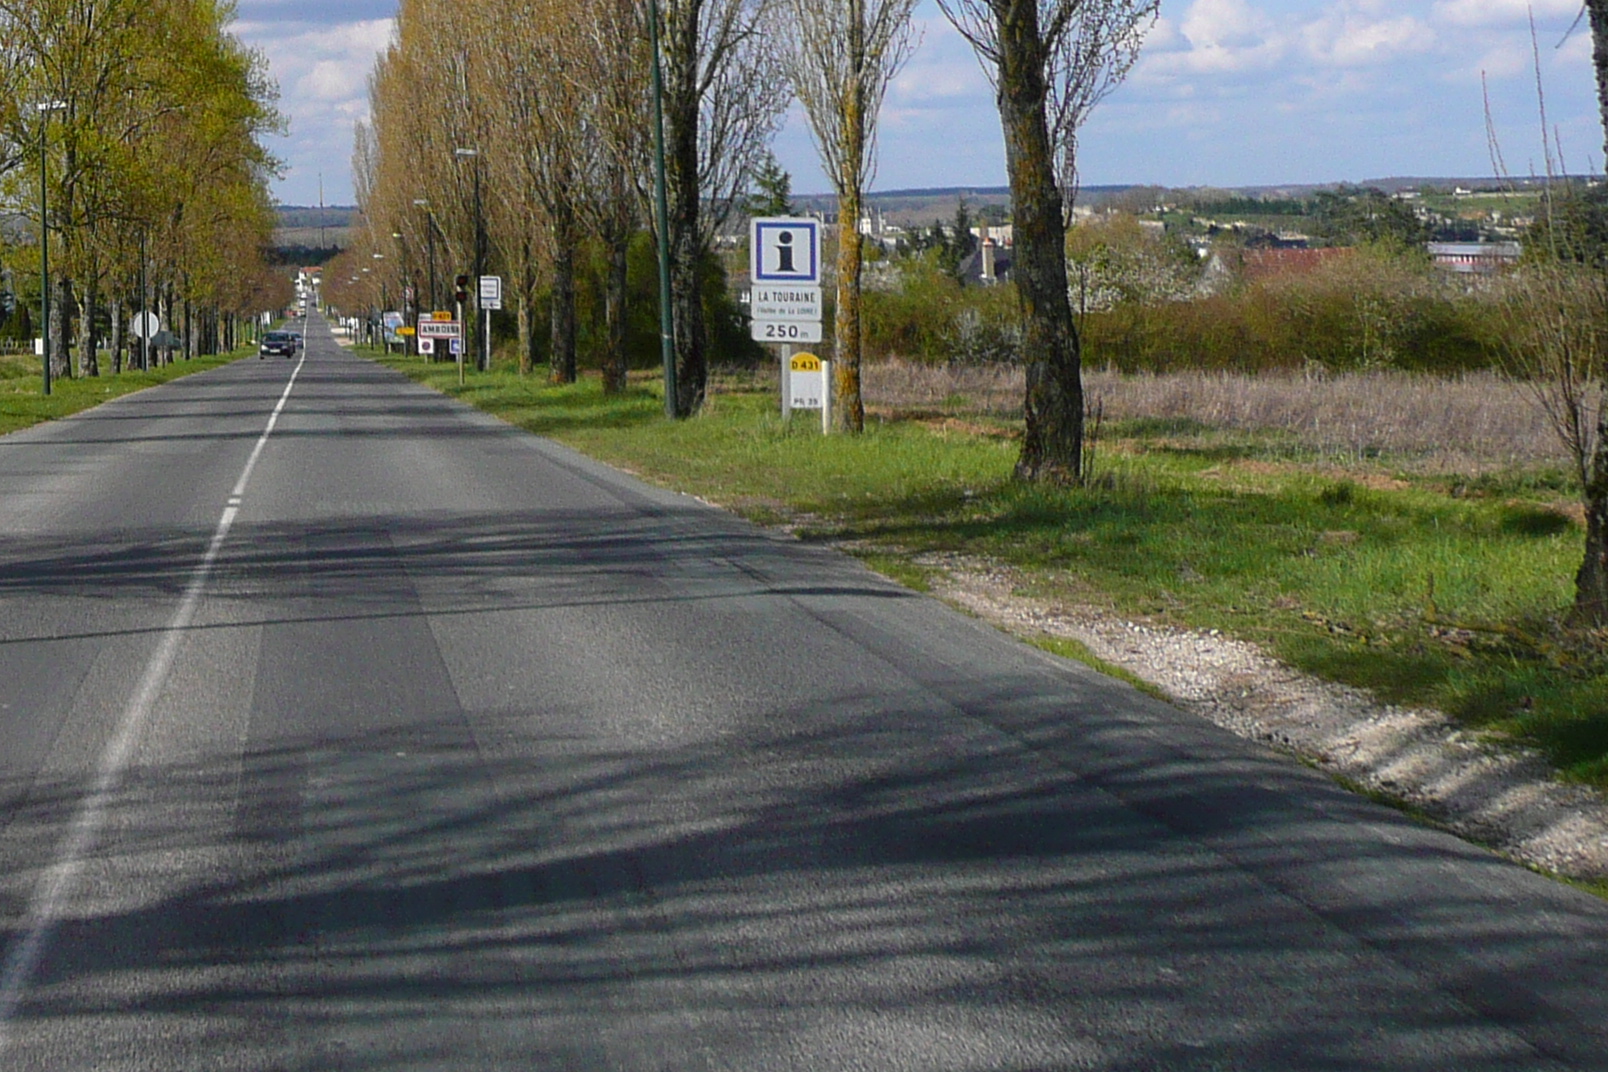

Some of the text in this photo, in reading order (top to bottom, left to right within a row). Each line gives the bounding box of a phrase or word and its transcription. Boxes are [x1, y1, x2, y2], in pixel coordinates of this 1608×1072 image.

[758, 291, 816, 303] LA TOURAINE
[766, 325, 798, 338] 250
[792, 361, 819, 369] D 431
